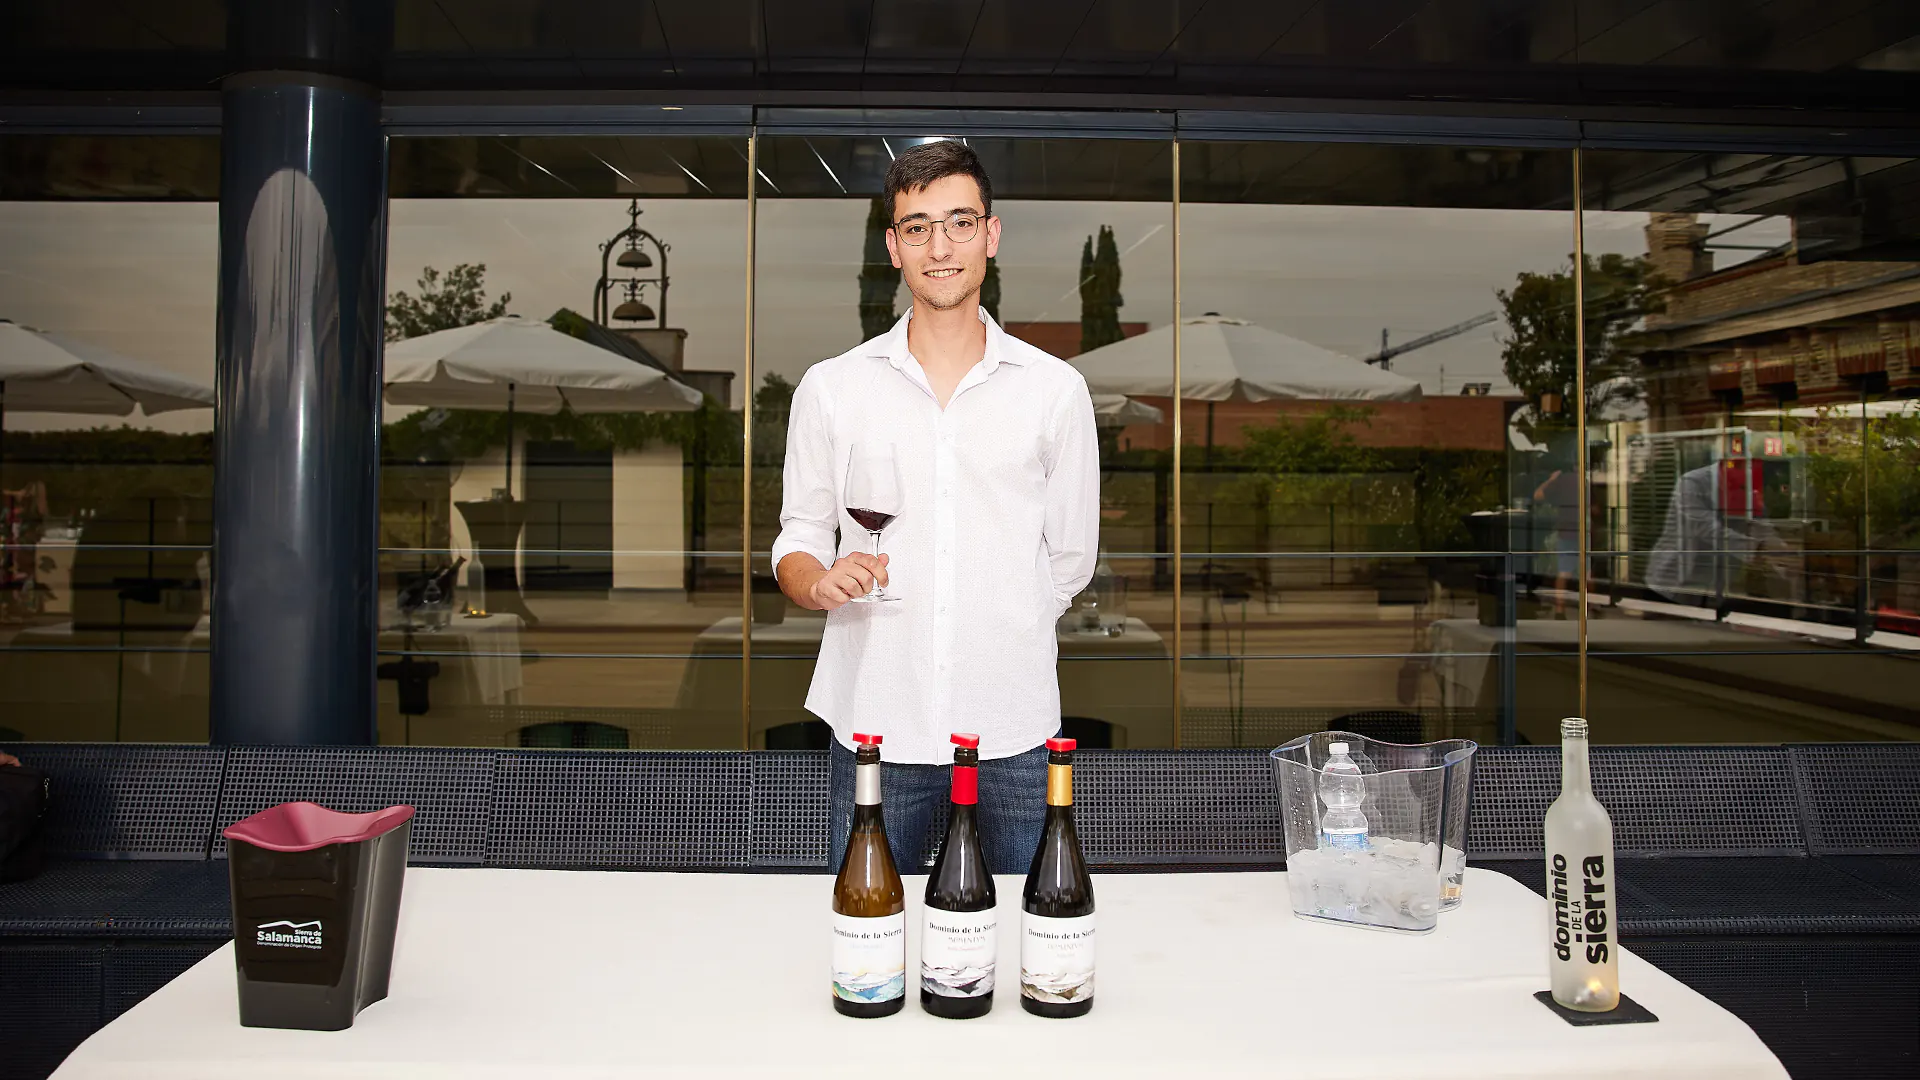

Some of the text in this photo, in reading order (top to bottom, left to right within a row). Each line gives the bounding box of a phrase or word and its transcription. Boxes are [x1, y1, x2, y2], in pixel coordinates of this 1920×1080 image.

[1551, 854, 1571, 962] dominio
[1576, 855, 1608, 965] sierra
[1571, 900, 1582, 930] DE LA
[883, 928, 902, 939] Sierra
[929, 922, 960, 934] Dominio
[962, 926, 972, 934] de
[1028, 928, 1059, 940] Dominio
[1061, 932, 1071, 940] de
[257, 931, 322, 944] Salamanca
